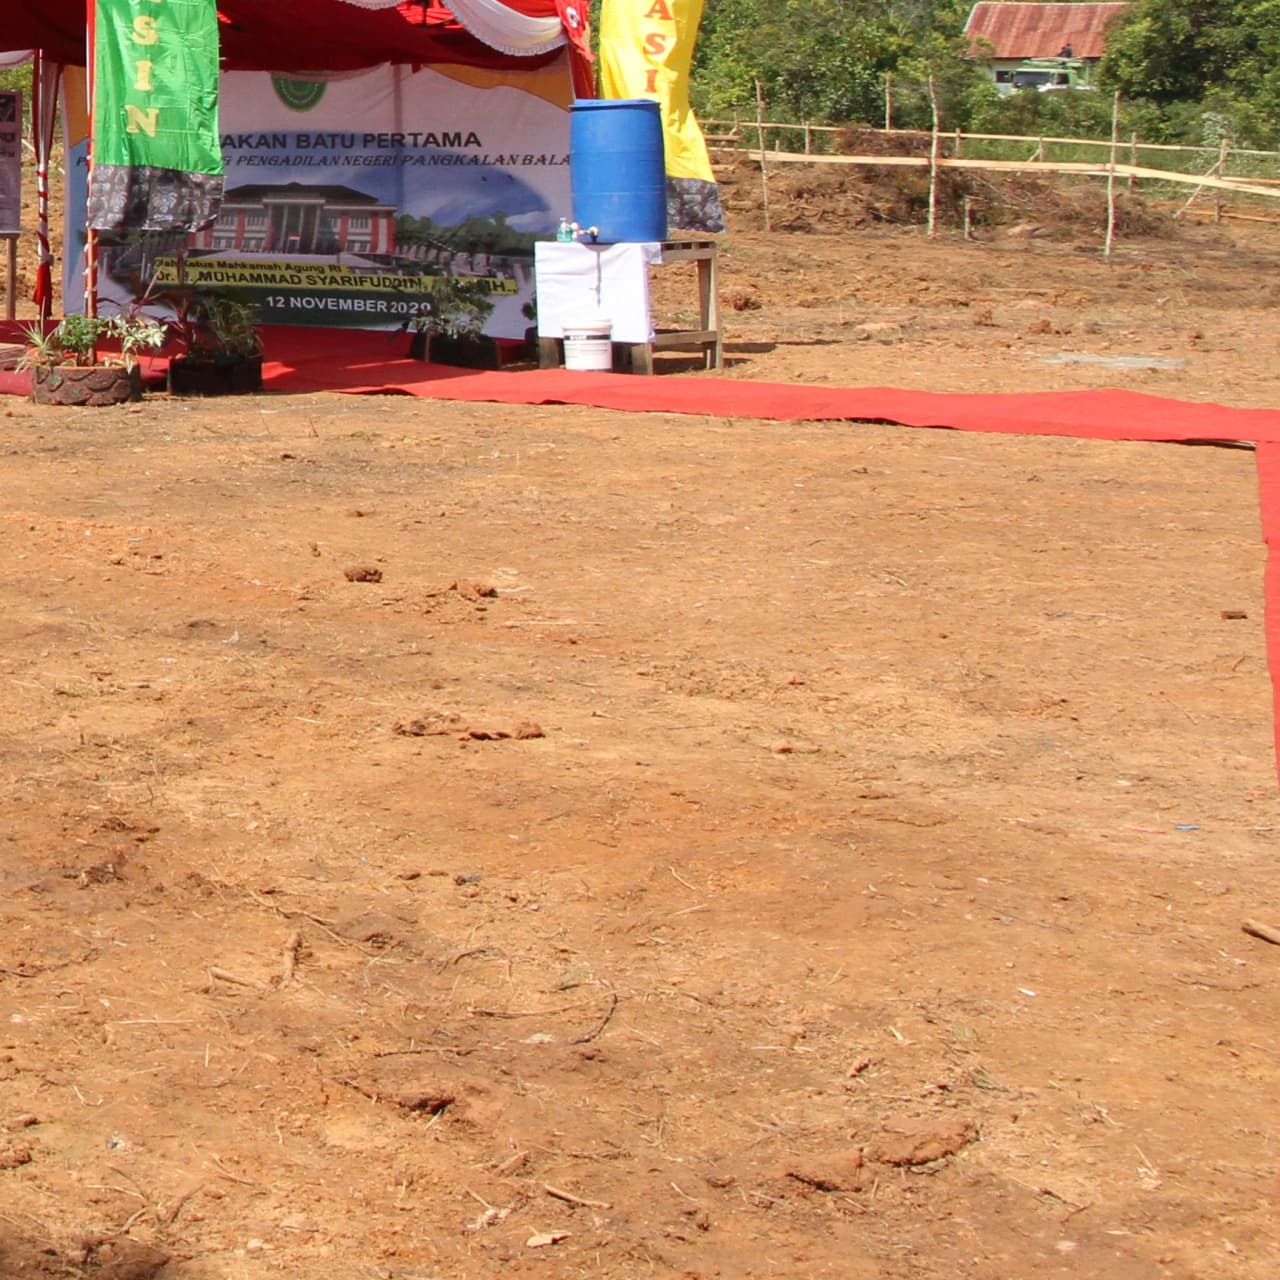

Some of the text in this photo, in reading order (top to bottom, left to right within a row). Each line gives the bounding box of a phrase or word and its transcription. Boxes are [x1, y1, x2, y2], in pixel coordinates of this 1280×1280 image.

[220, 131, 482, 150] AKAN BATU PERTAMA
[236, 154, 340, 167] PENGADILAN
[342, 154, 397, 167] NEGERI
[399, 153, 518, 167] PANGKALAN
[521, 152, 571, 167] BALA
[285, 262, 327, 275] Agung
[199, 271, 303, 286] MUHAMMAD
[266, 296, 286, 308] 12
[290, 296, 388, 313] NOVEMBER
